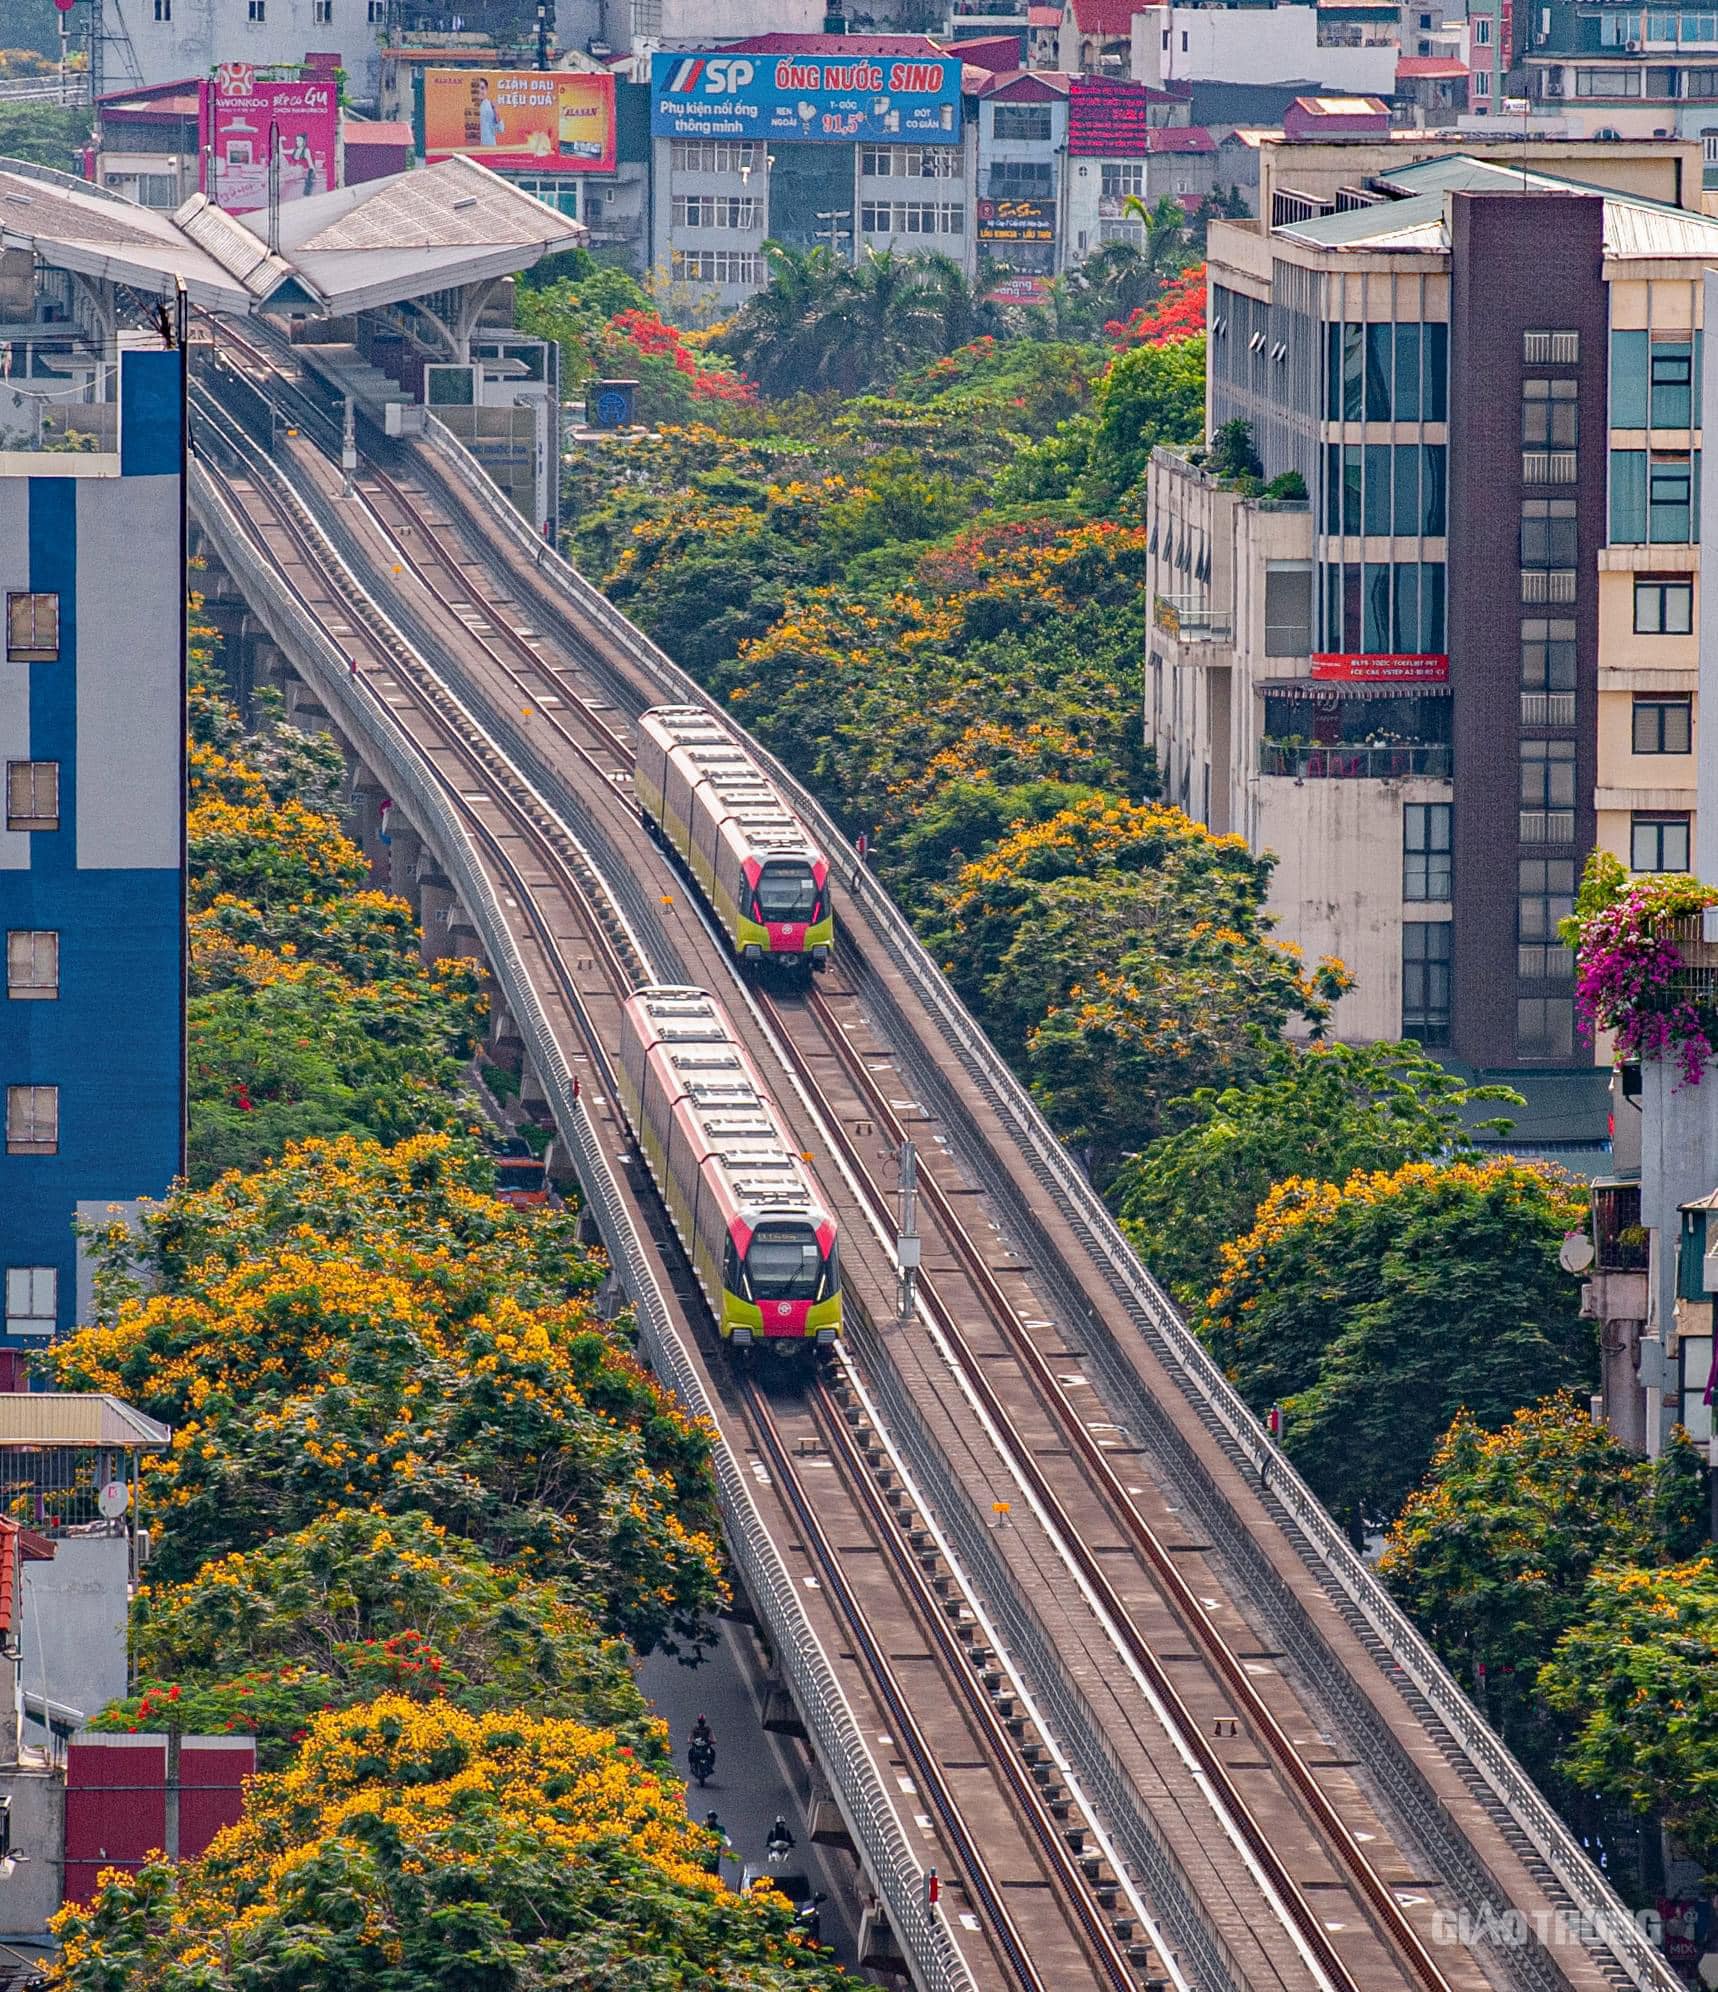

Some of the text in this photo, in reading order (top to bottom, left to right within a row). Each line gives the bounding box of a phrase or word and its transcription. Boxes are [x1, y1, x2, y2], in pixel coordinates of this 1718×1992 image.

[705, 59, 754, 93] SP
[775, 57, 944, 93] ỐNG NƯỚC SINO
[660, 99, 758, 117] Phụ kiện nối ống
[675, 119, 743, 134] thông minh
